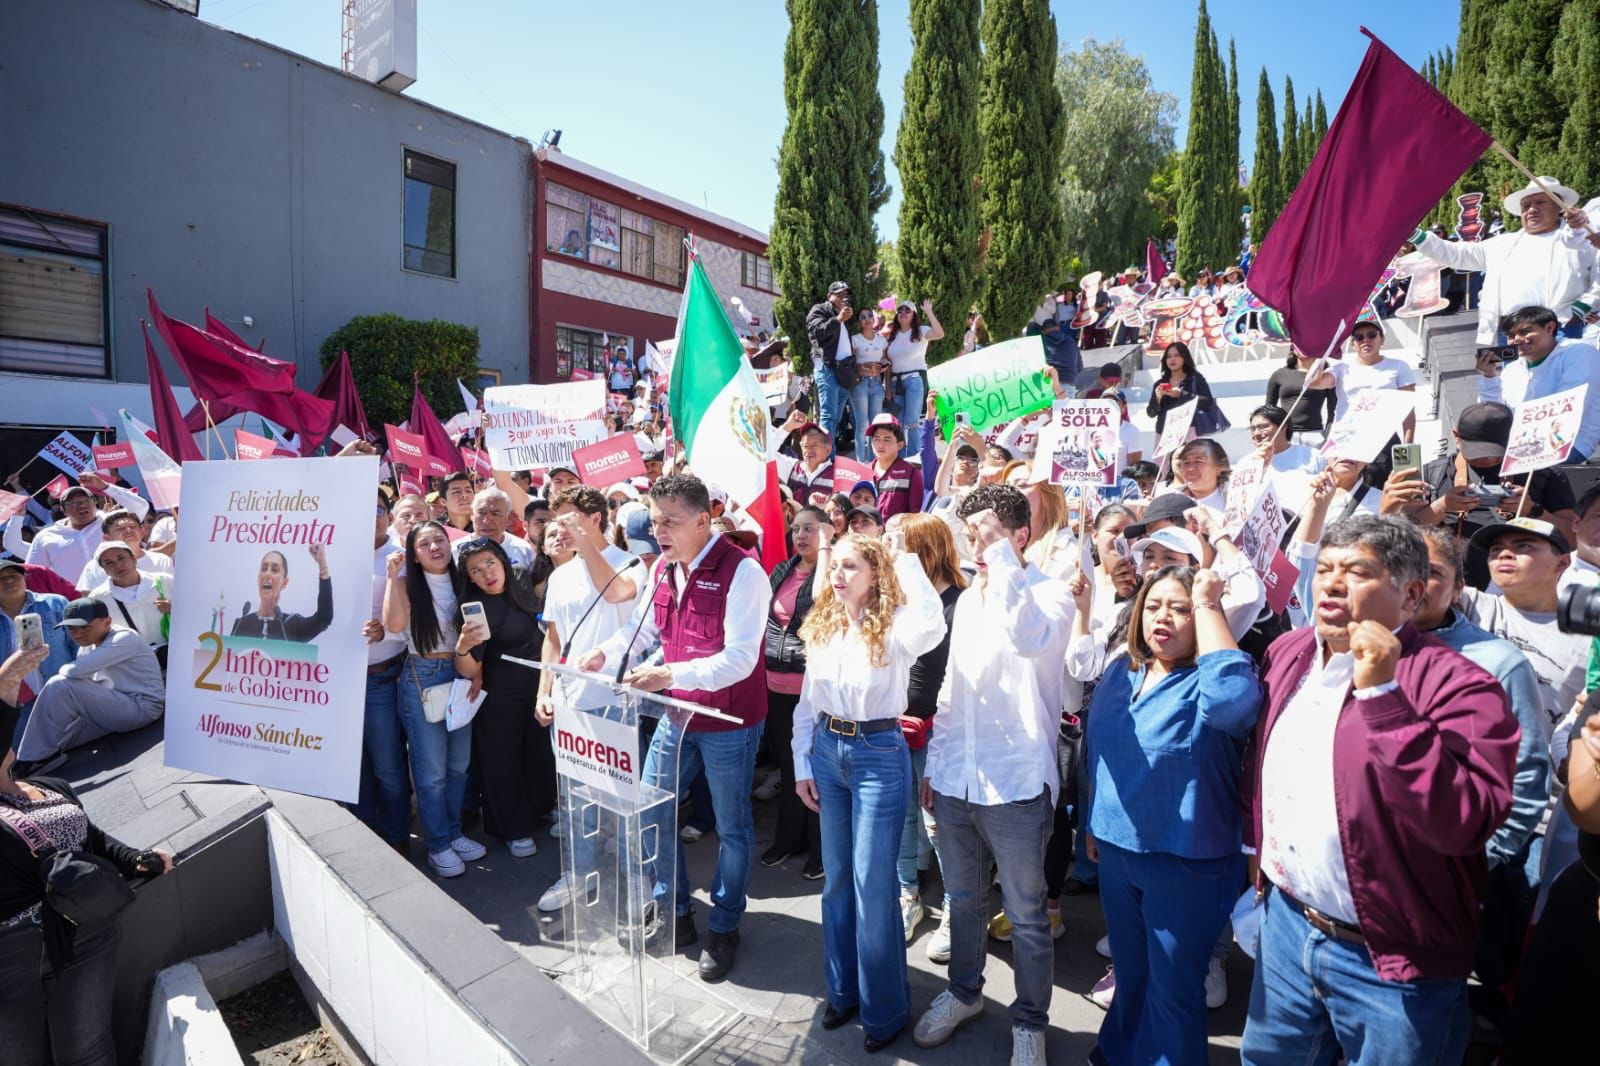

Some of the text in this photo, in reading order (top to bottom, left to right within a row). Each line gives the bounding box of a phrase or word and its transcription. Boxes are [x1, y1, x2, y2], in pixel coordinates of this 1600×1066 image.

[1061, 407, 1111, 415] NO ESTAS
[1061, 415, 1109, 427] SOLA
[1521, 402, 1574, 425] SOLA
[395, 439, 420, 454] morena
[516, 429, 533, 443] que
[585, 450, 630, 472] morena
[227, 488, 320, 512] Felicidades
[208, 514, 336, 545] Presidenta
[194, 631, 223, 692] 2
[225, 648, 330, 684] Informe
[224, 675, 330, 706] de Gobierno
[196, 713, 323, 750] Alfonso Sánchez
[557, 729, 633, 773] morena
[558, 750, 633, 785] La esperanza de México
